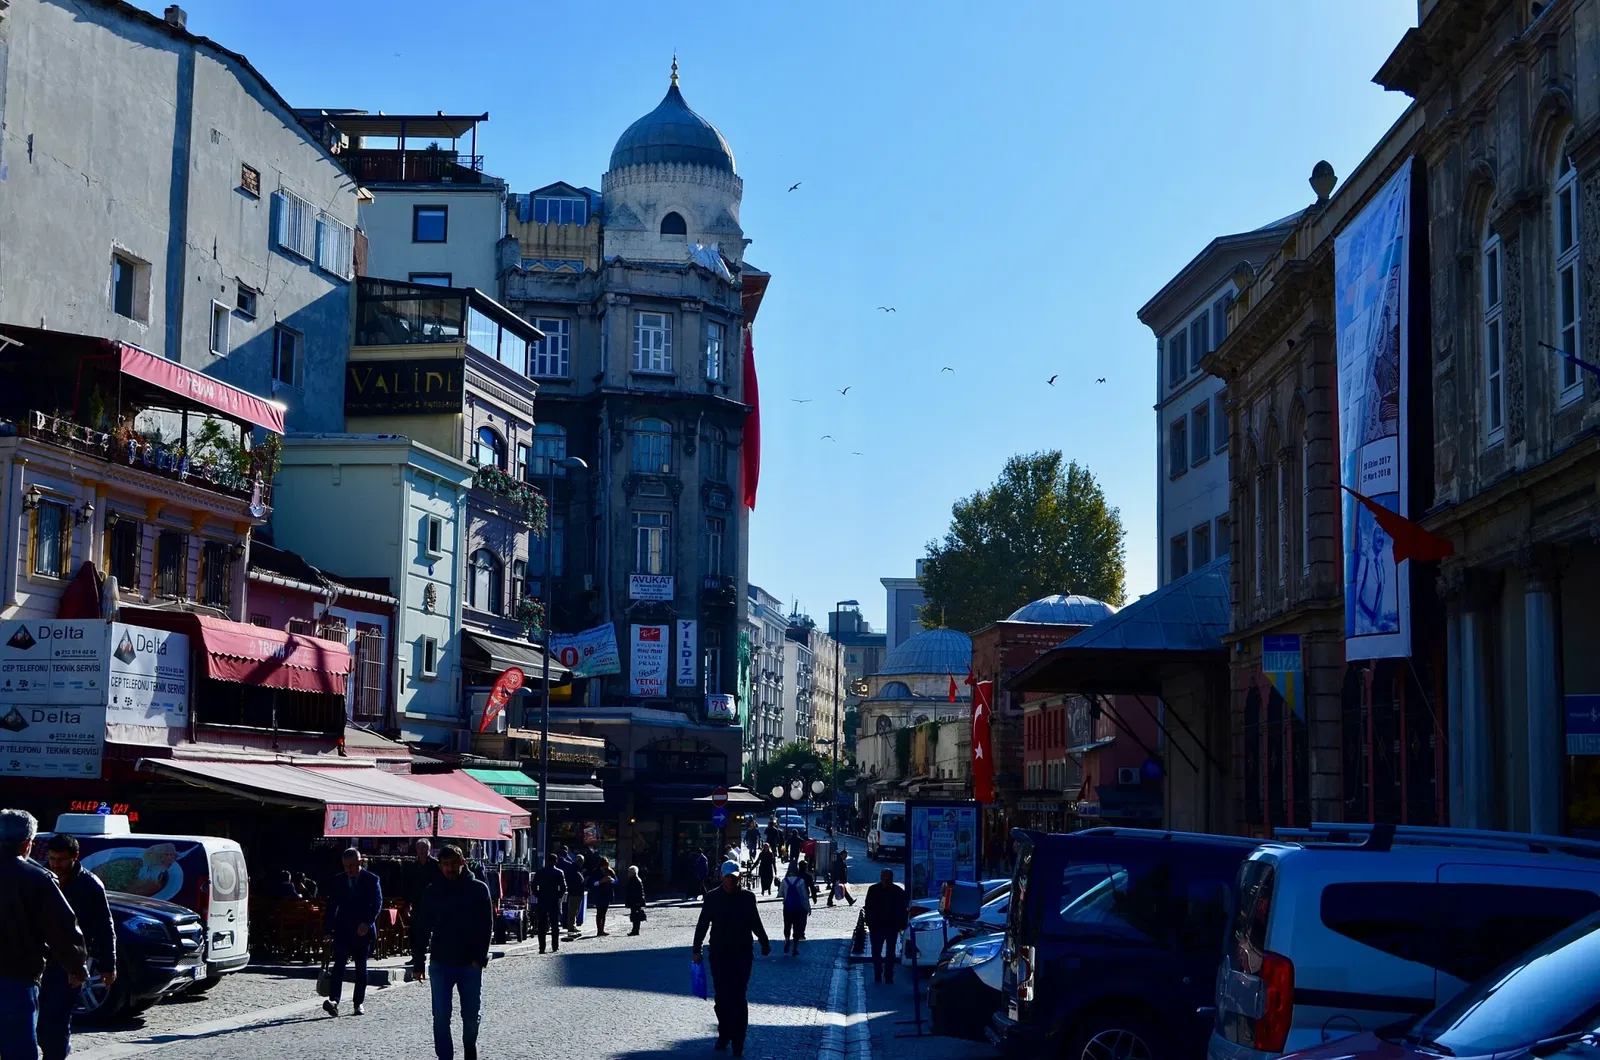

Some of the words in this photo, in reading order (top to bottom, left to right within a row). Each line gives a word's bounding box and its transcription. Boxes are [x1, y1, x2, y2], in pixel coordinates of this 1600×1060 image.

[1379, 455, 1391, 466] 2017
[1368, 471, 1377, 480] Mart
[1378, 468, 1391, 478] 2018
[632, 576, 672, 585] AVUKAT
[38, 626, 84, 640] Delta
[136, 634, 167, 656] Delta
[681, 621, 692, 676] YILDIZ
[2, 664, 15, 672] CEP
[16, 664, 49, 672] TELEFONU
[52, 663, 75, 672] TEKNİK
[76, 662, 101, 672] SERVİSİ
[111, 676, 122, 688] CEP
[123, 677, 149, 691] TELEFONU
[150, 680, 167, 693] TEKNİK
[168, 682, 186, 695] SERVİSİ
[711, 700, 727, 711] 70
[31, 709, 81, 724] Delta
[6, 746, 42, 754] TELEFONU
[45, 746, 70, 755] TEKNİK
[72, 746, 99, 756] SERVİSİ
[70, 800, 99, 811] SALEP
[112, 803, 130, 815] ÇAY
